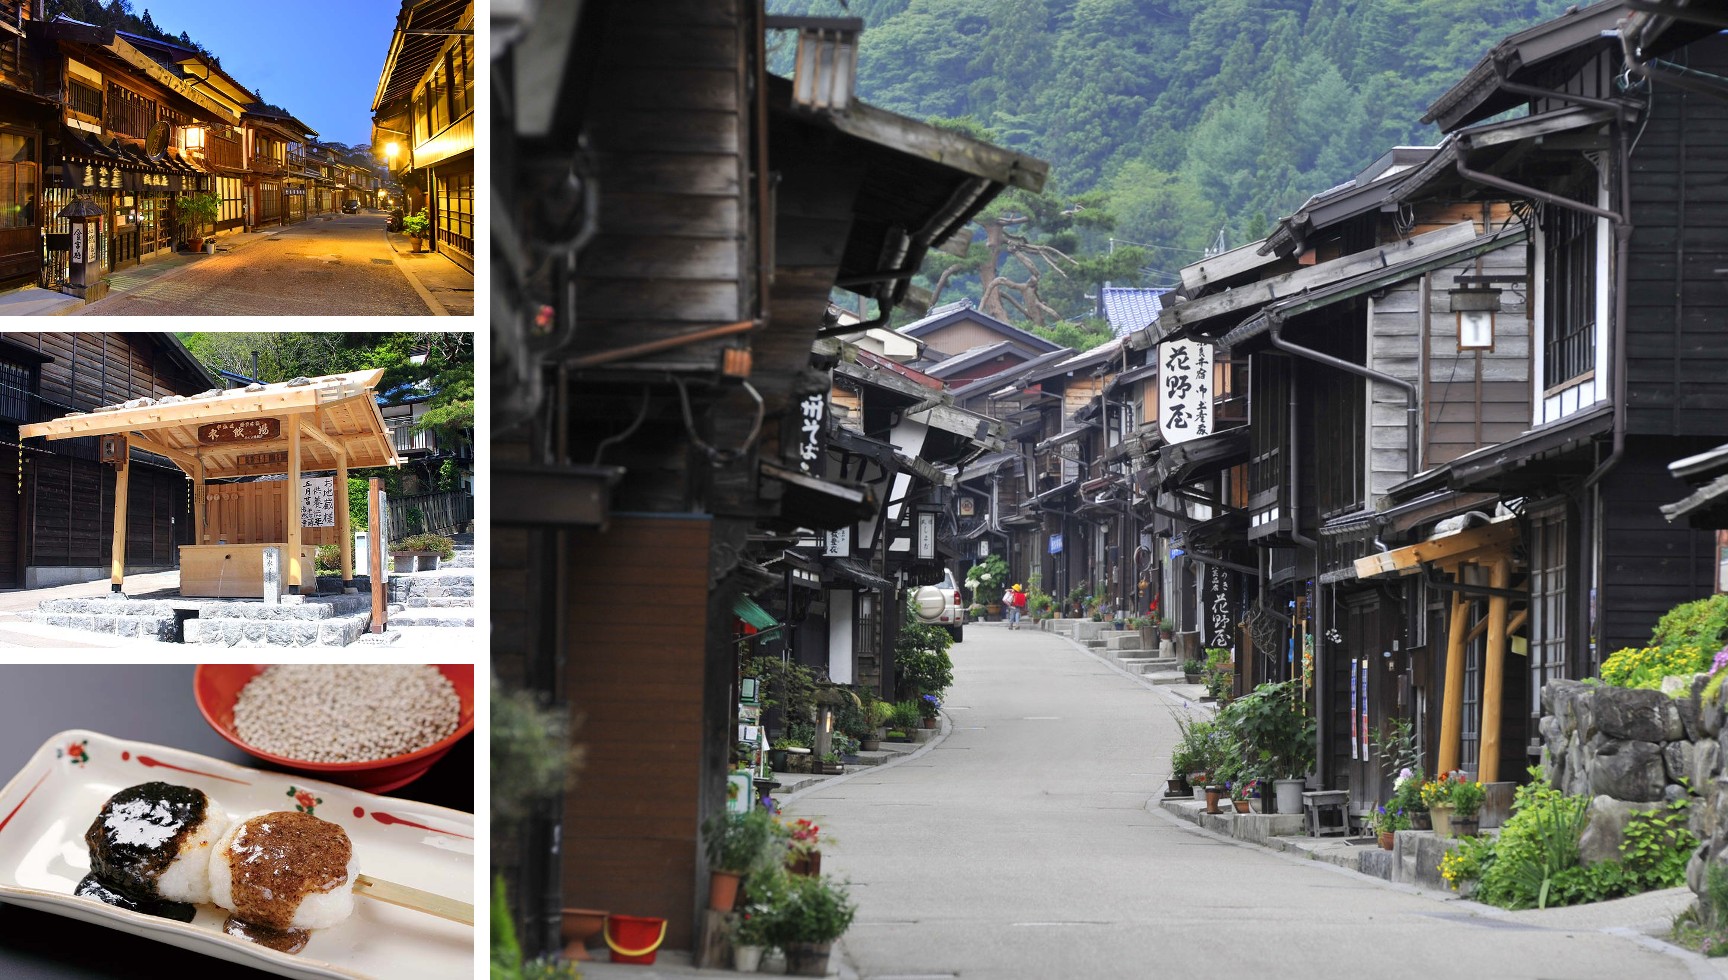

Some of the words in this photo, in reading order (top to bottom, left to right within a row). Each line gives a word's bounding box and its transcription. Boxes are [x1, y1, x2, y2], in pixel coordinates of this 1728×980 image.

[1165, 345, 1192, 430] 花野屋
[1211, 593, 1231, 647] 花野屋
